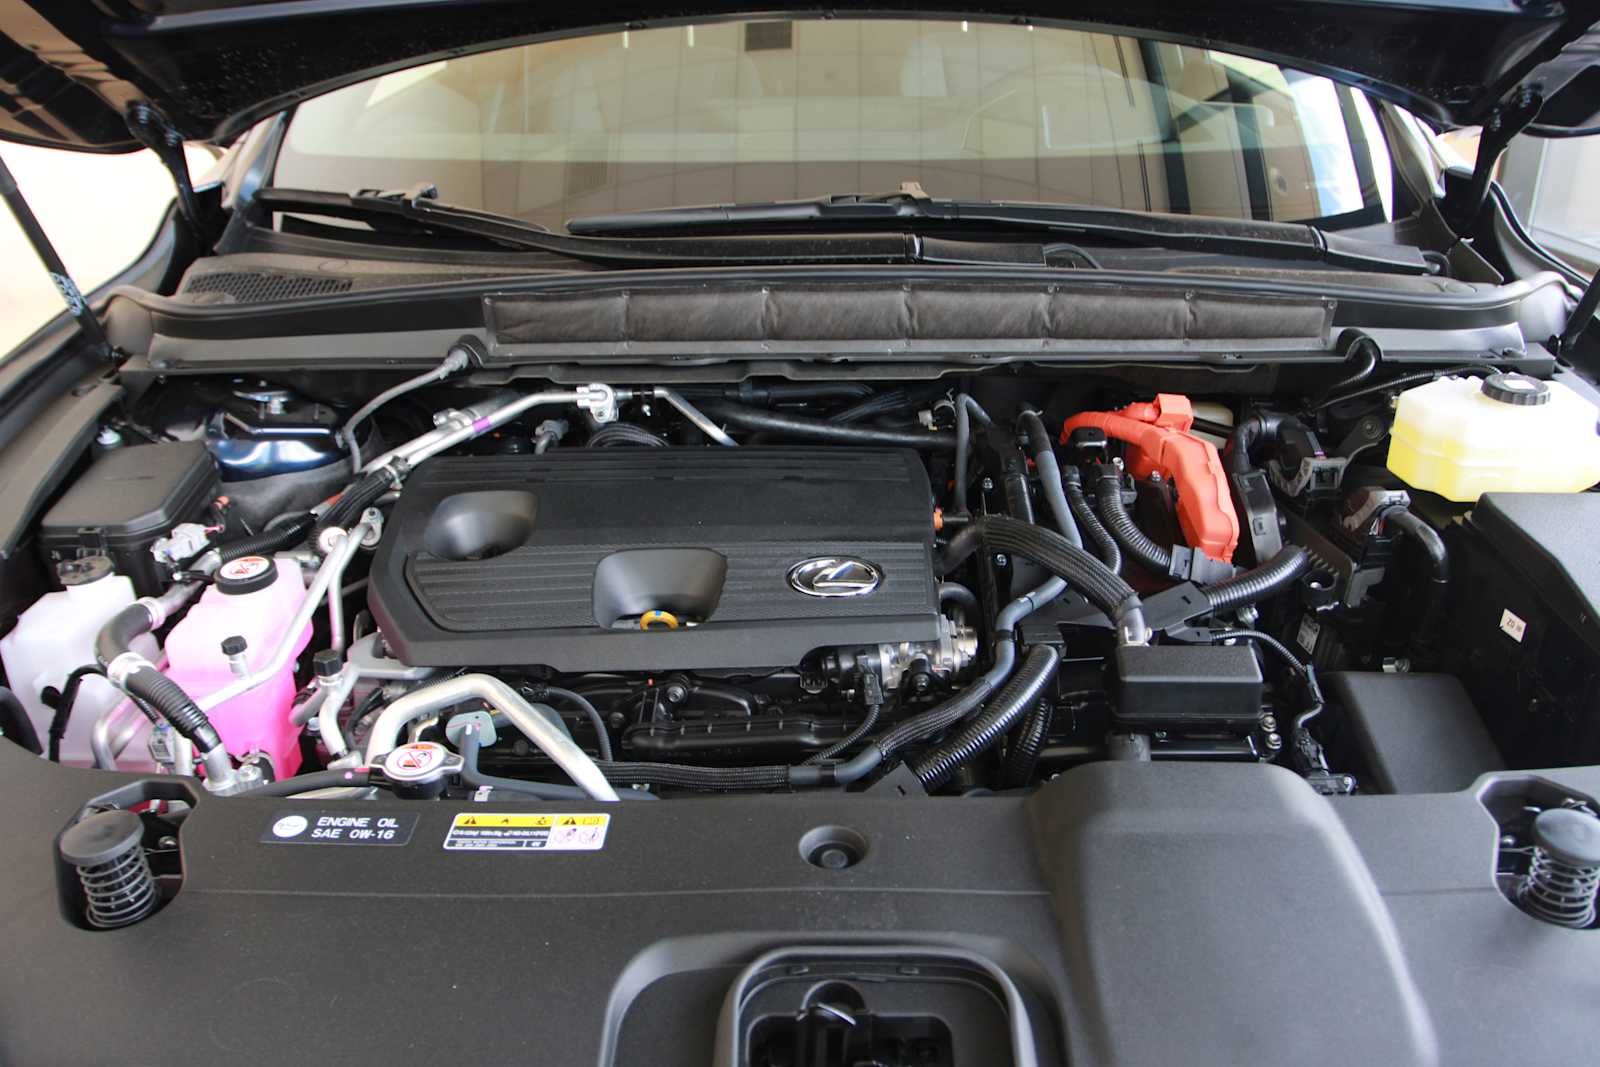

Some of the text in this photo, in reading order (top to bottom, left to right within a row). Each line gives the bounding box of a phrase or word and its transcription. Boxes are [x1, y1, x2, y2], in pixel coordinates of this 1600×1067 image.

[317, 816, 370, 828] ENGINE
[377, 817, 399, 828] OIL
[311, 828, 396, 840] SAE 0W-16
